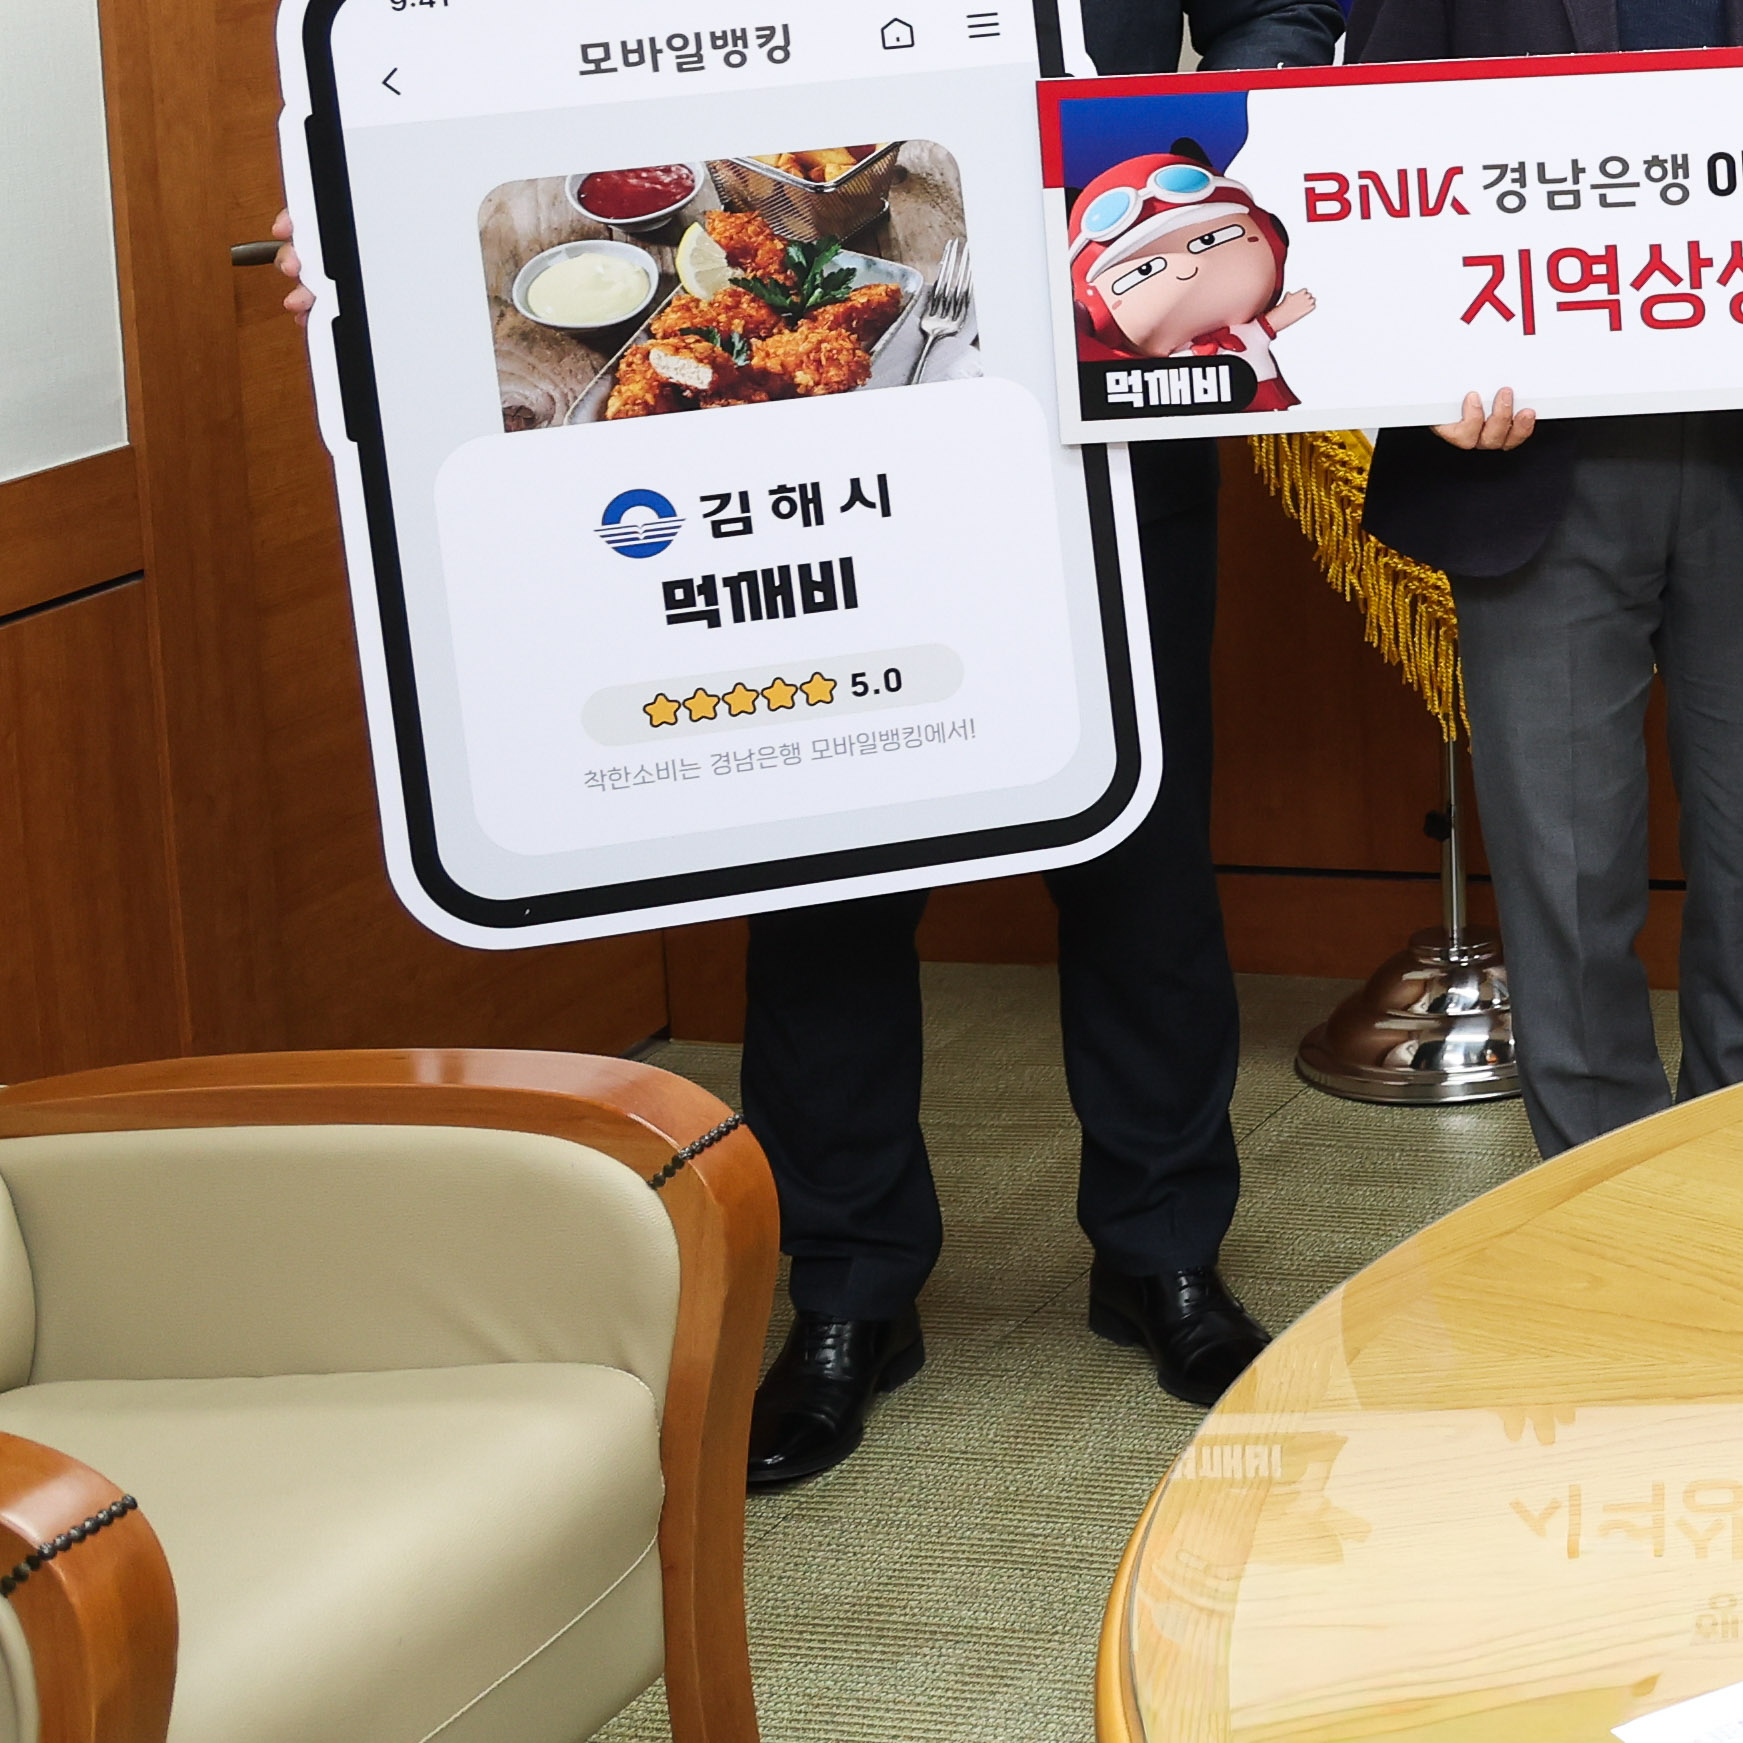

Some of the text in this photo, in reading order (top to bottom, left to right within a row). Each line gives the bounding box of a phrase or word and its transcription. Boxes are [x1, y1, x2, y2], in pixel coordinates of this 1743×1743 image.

[578, 23, 791, 76] 모바일뱅킹
[1303, 165, 1471, 223] BNK
[1481, 153, 1690, 215] 경남은행
[1105, 363, 1232, 408] 먹깨비
[699, 473, 892, 539] 김해시
[661, 556, 859, 630] 먹깨비
[851, 667, 903, 698] 5.0
[584, 717, 976, 792] 착한소비는 경남은행 모바일뱅킹에서!
